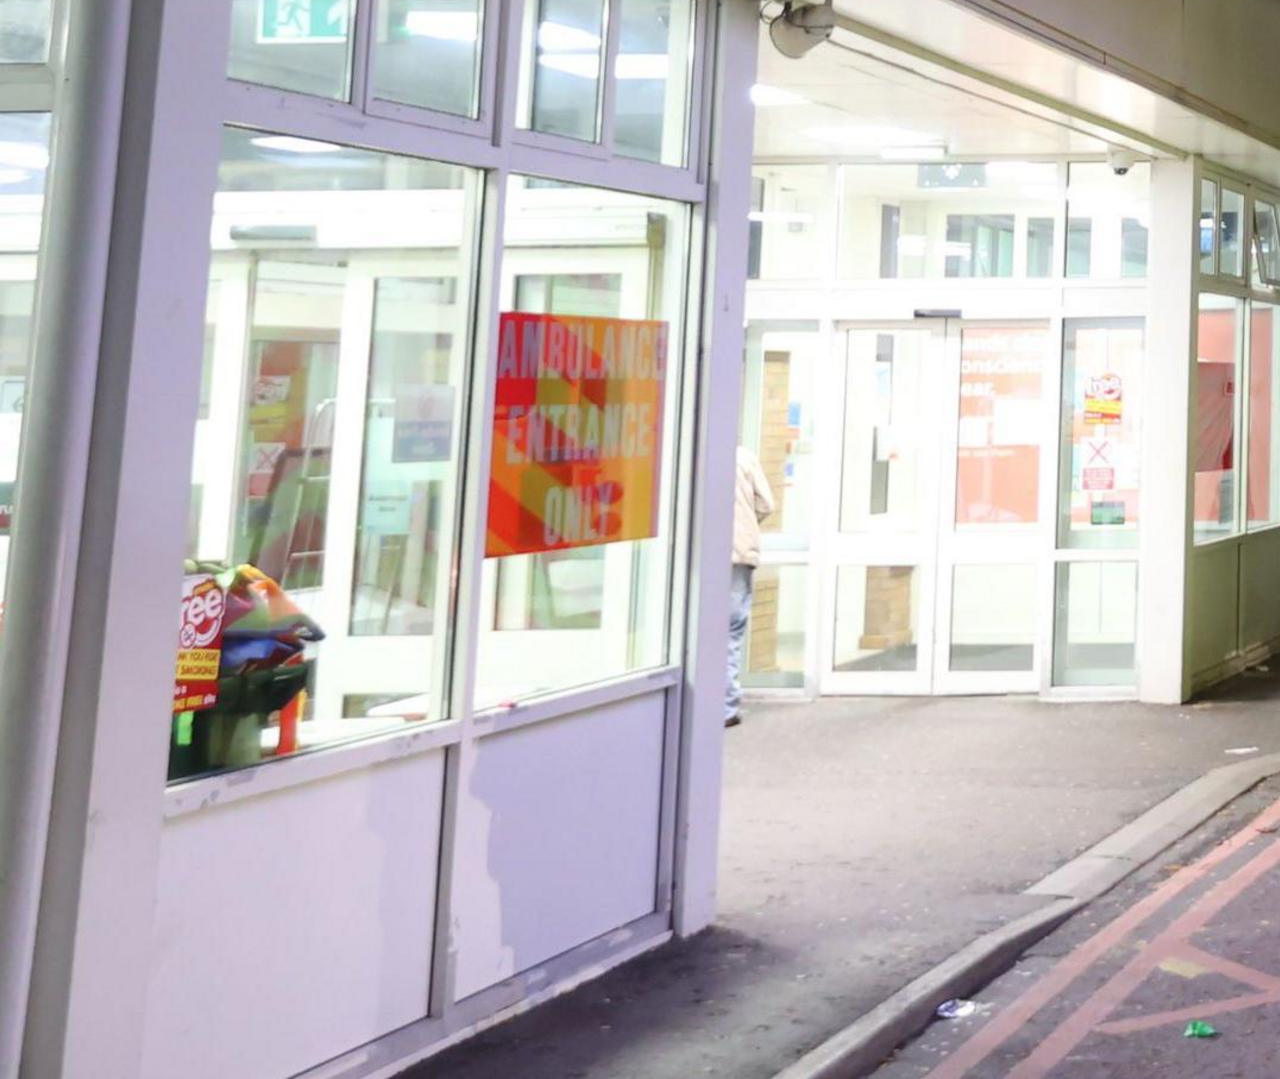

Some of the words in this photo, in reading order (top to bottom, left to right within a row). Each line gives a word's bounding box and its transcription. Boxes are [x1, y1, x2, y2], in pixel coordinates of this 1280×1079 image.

[498, 320, 669, 380] AMBULANCE
[506, 404, 650, 465] ENTRANCE
[543, 483, 617, 546] ONLY
[180, 588, 223, 626] ree
